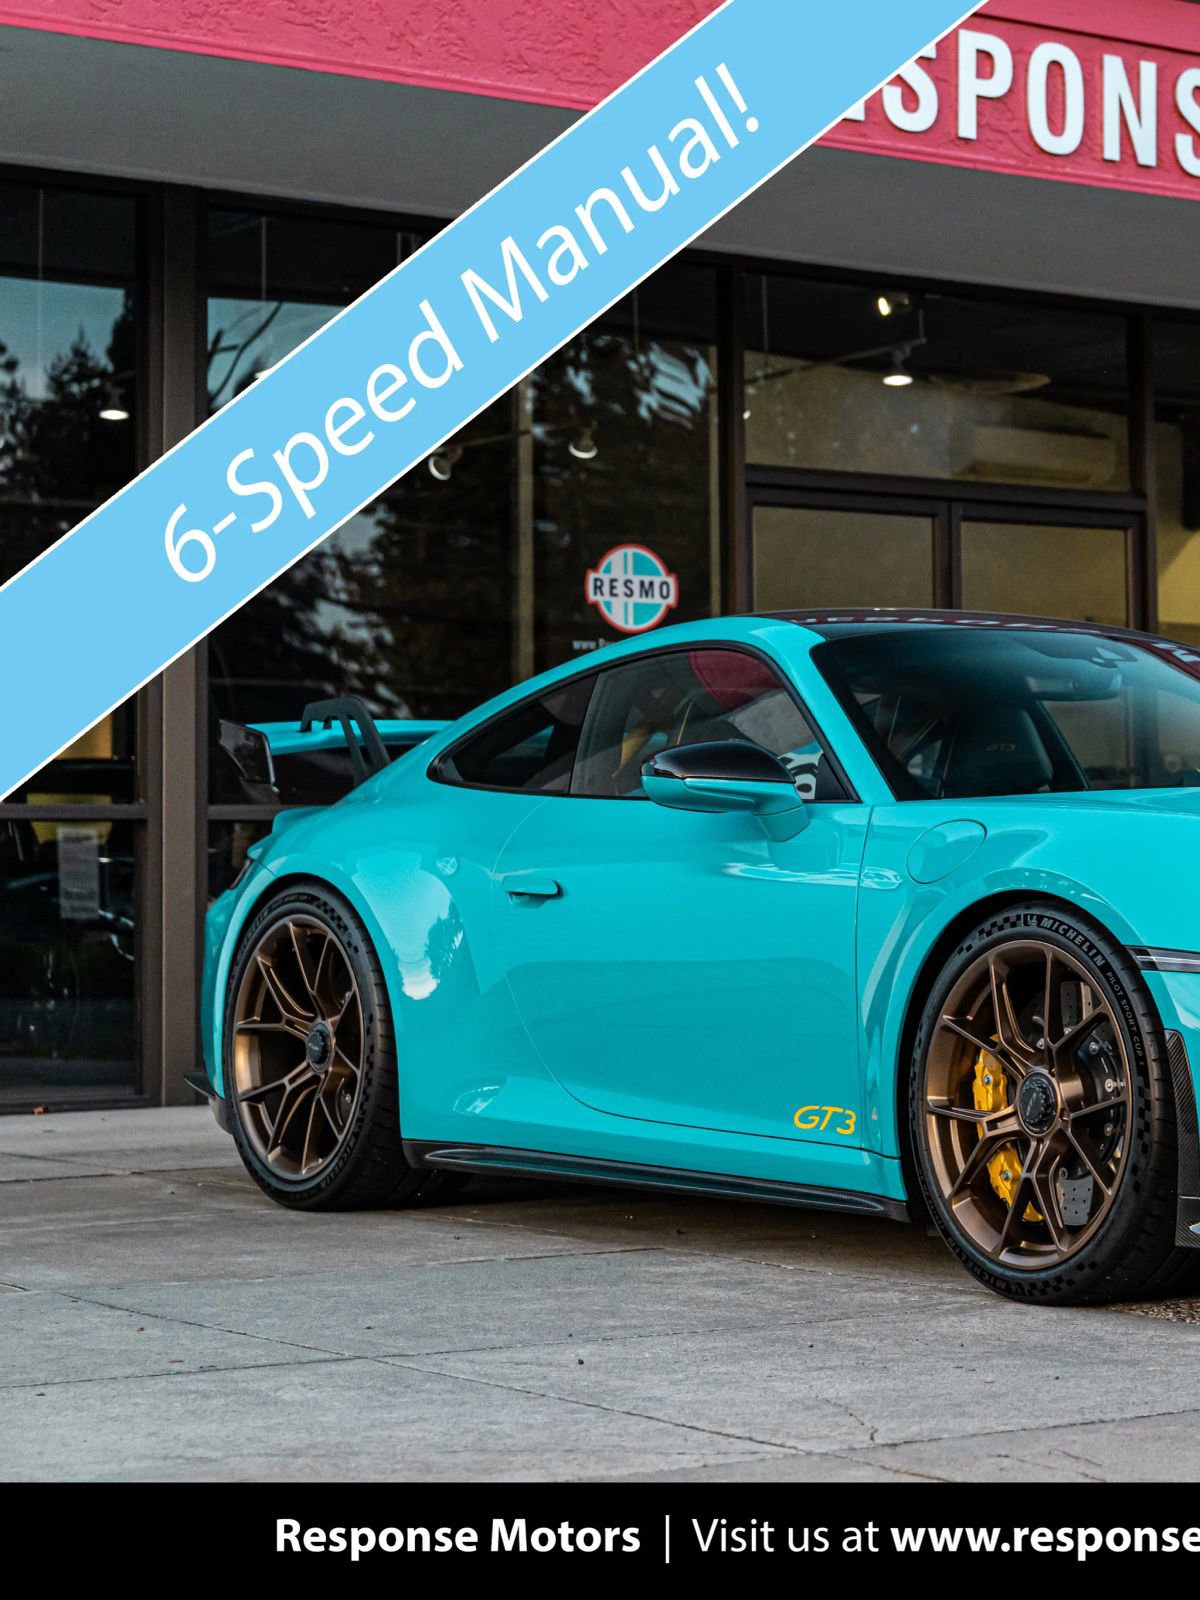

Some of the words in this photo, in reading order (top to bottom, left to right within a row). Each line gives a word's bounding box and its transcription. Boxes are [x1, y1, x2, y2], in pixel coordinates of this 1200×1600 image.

[592, 577, 671, 600] RESMO
[1040, 917, 1106, 967] MICHELIN
[1106, 971, 1123, 996] PILOT
[1120, 999, 1138, 1033] SPORT
[1132, 1035, 1144, 1057] CUP
[793, 1105, 856, 1135] GT3
